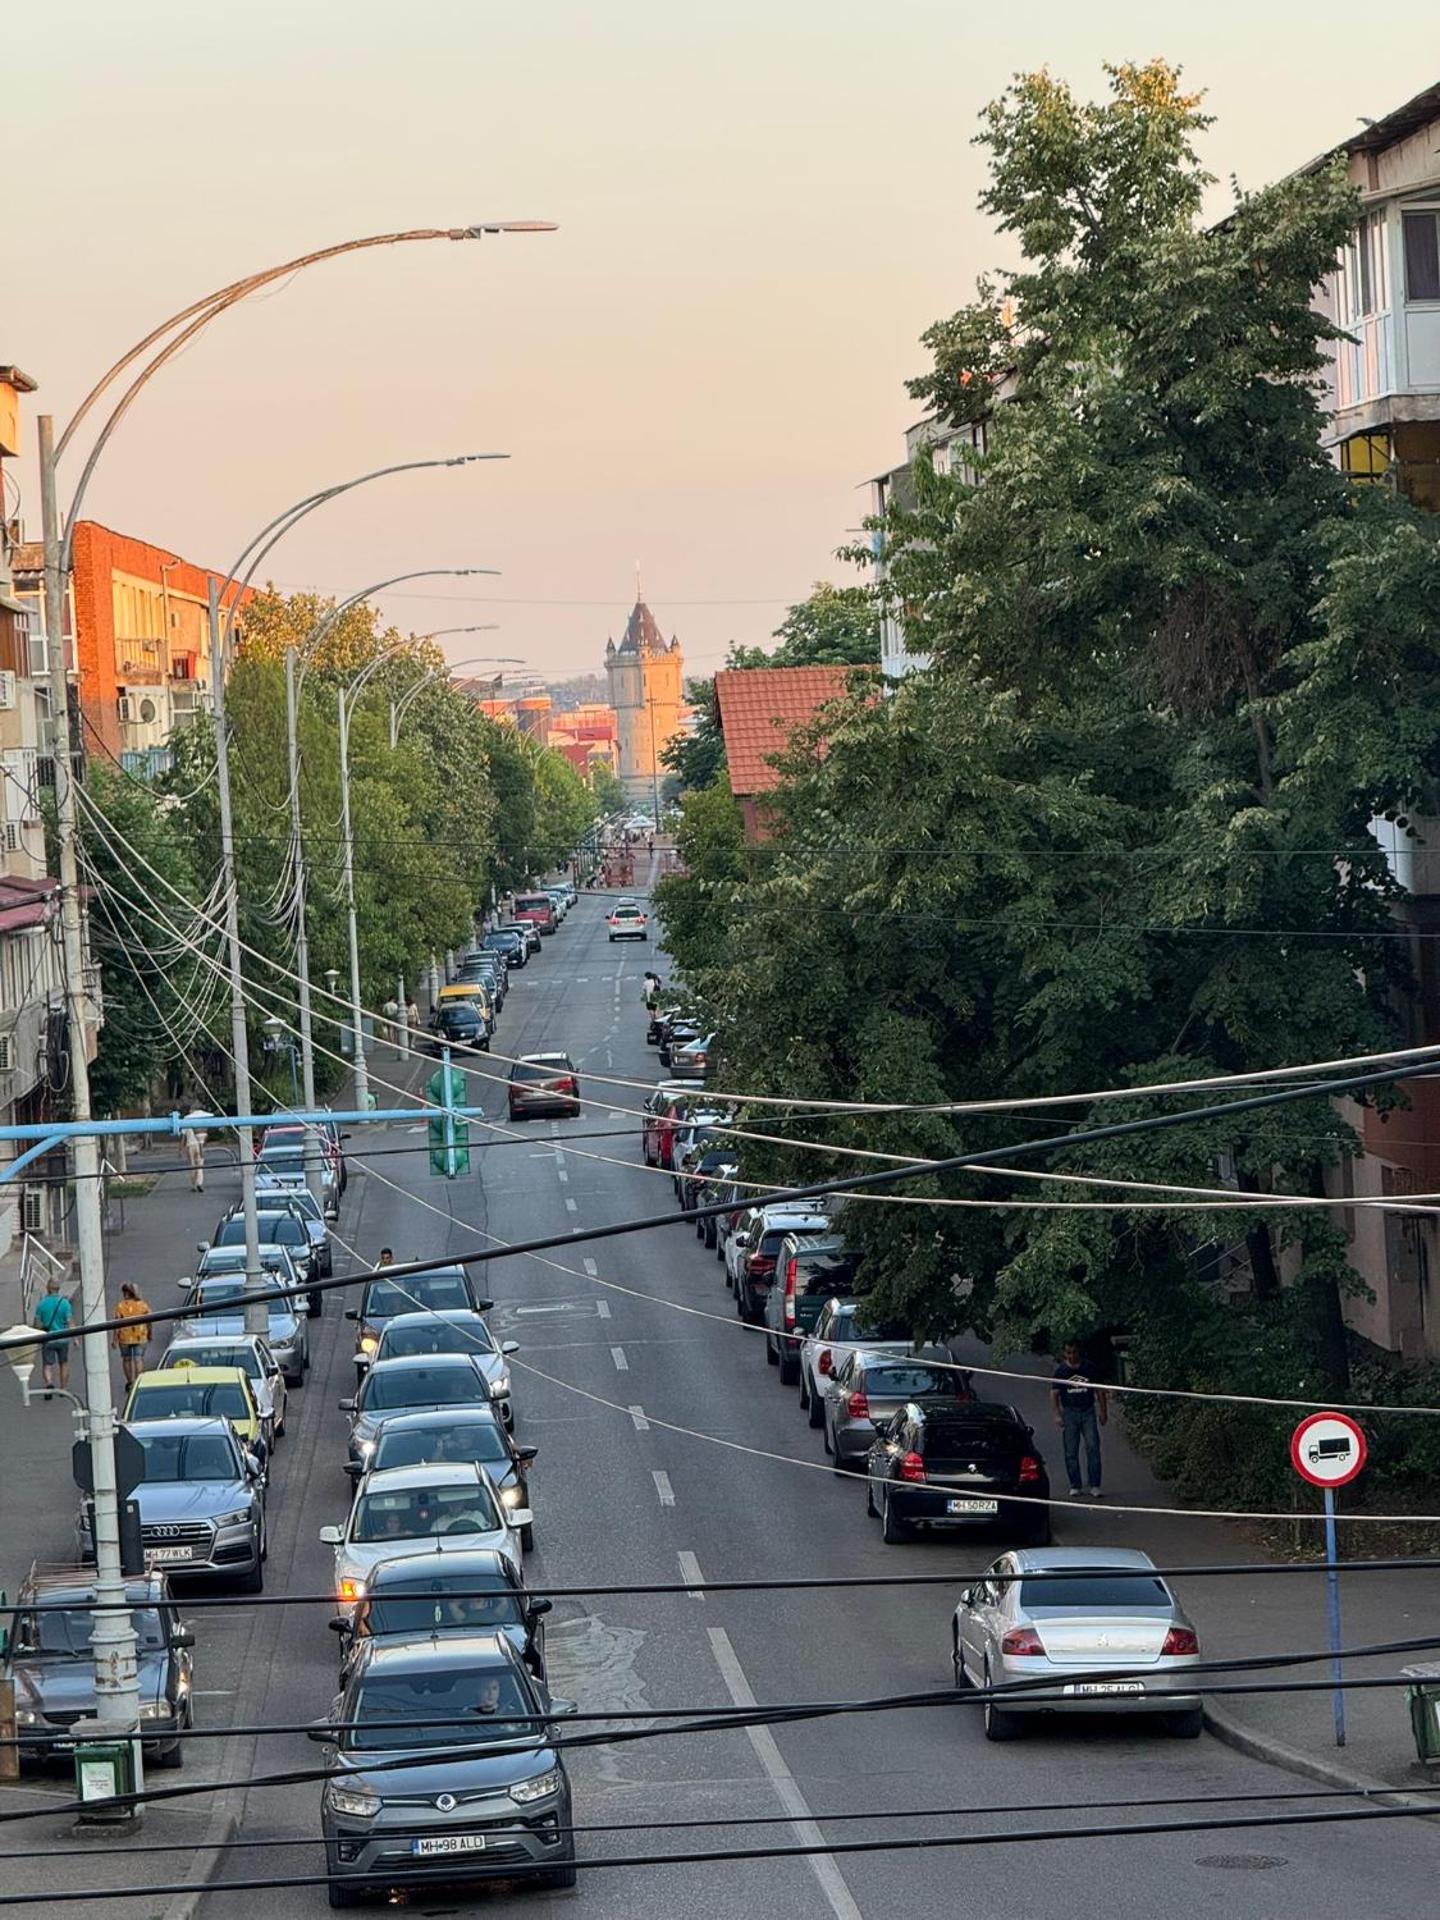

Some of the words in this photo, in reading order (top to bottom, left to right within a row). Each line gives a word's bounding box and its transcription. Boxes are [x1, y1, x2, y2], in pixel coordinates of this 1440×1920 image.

[171, 1547, 190, 1557] WLK
[420, 1840, 439, 1853] MH
[442, 1838, 457, 1850] 98
